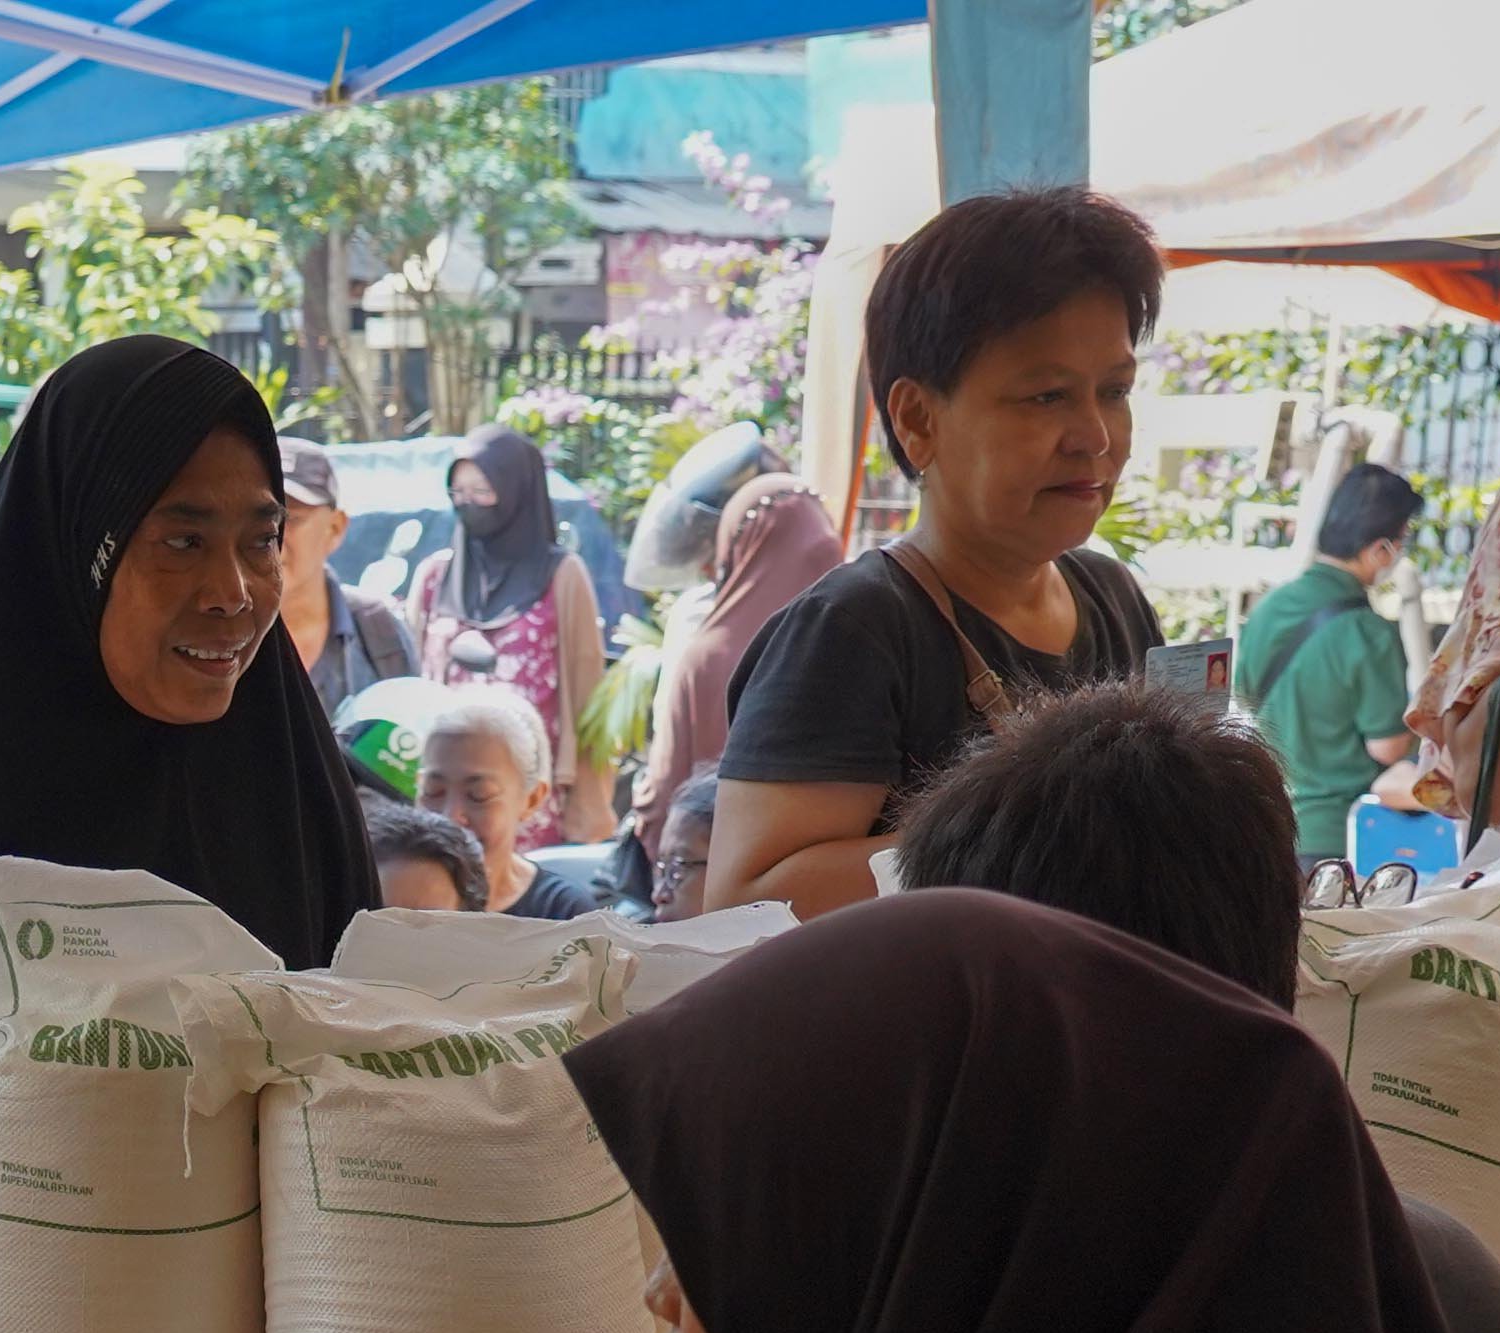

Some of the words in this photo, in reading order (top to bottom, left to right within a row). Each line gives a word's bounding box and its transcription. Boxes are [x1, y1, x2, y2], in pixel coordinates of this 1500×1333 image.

[63, 926, 102, 936] BADAN
[63, 937, 109, 947] PANGAN
[62, 948, 118, 958] NASIONAL
[28, 1018, 195, 1070] BANTUA
[1372, 1071, 1400, 1086] TIDAK
[1401, 1078, 1434, 1096] UNTUK
[0, 1161, 28, 1175] TIDAK
[30, 1167, 63, 1181] UNTUK
